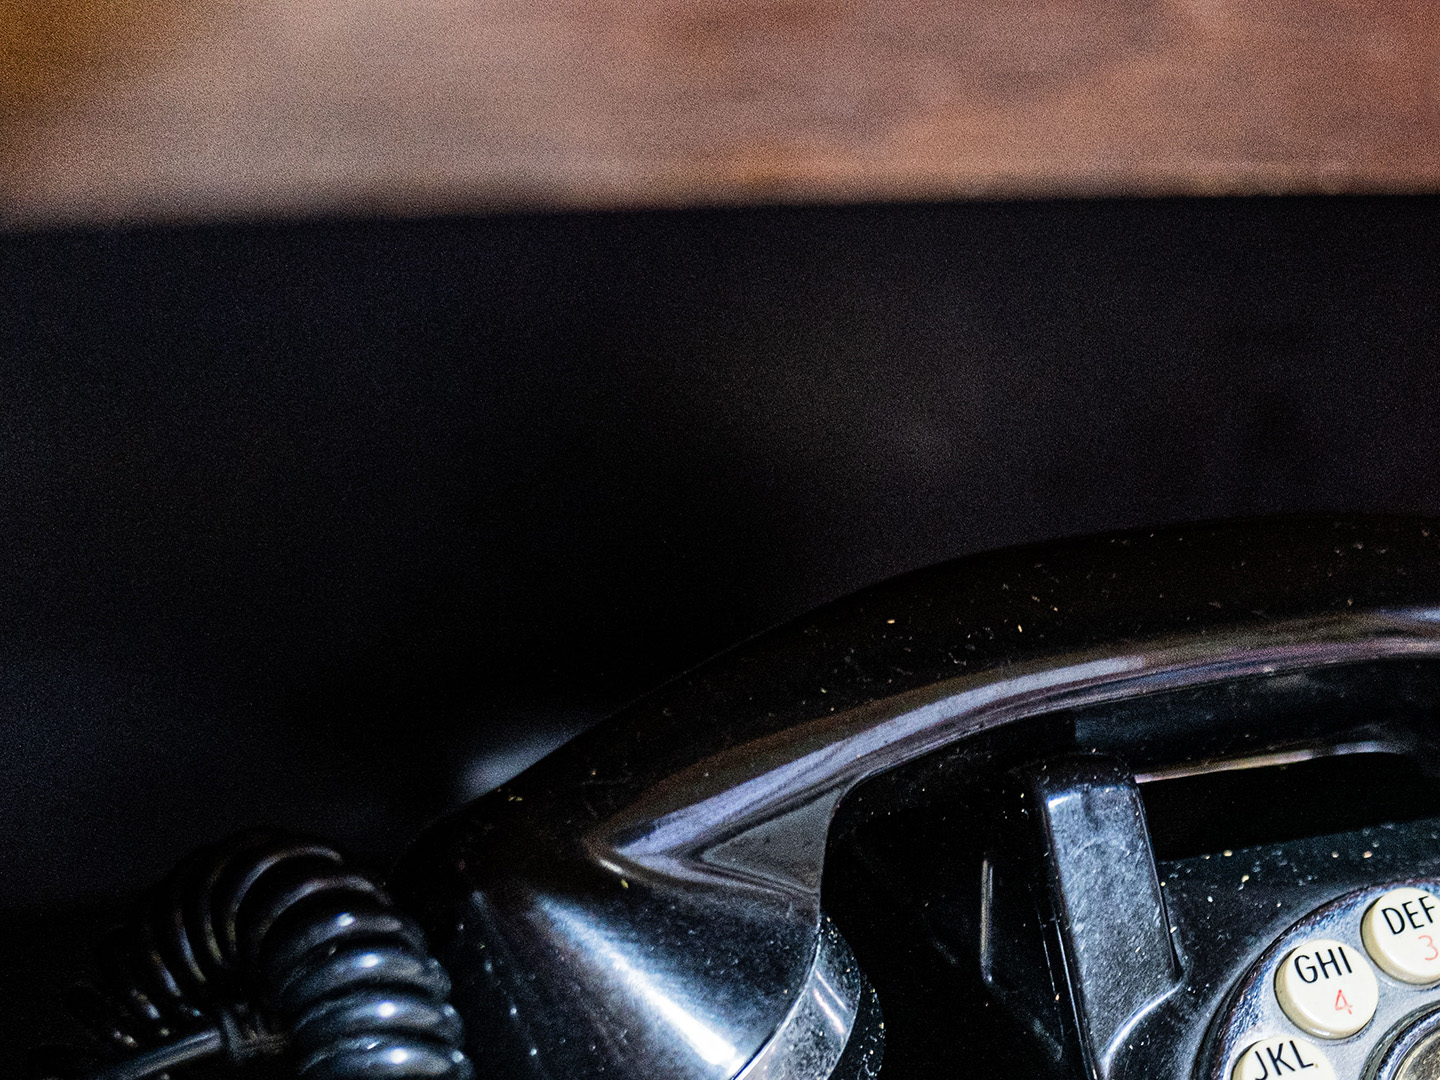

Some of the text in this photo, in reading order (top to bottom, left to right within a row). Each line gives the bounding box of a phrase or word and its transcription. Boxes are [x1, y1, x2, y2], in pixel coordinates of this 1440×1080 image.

[1381, 895, 1436, 935] DEF
[1418, 934, 1439, 961] 3
[1294, 946, 1353, 984] GHI
[1334, 989, 1353, 1015] 4
